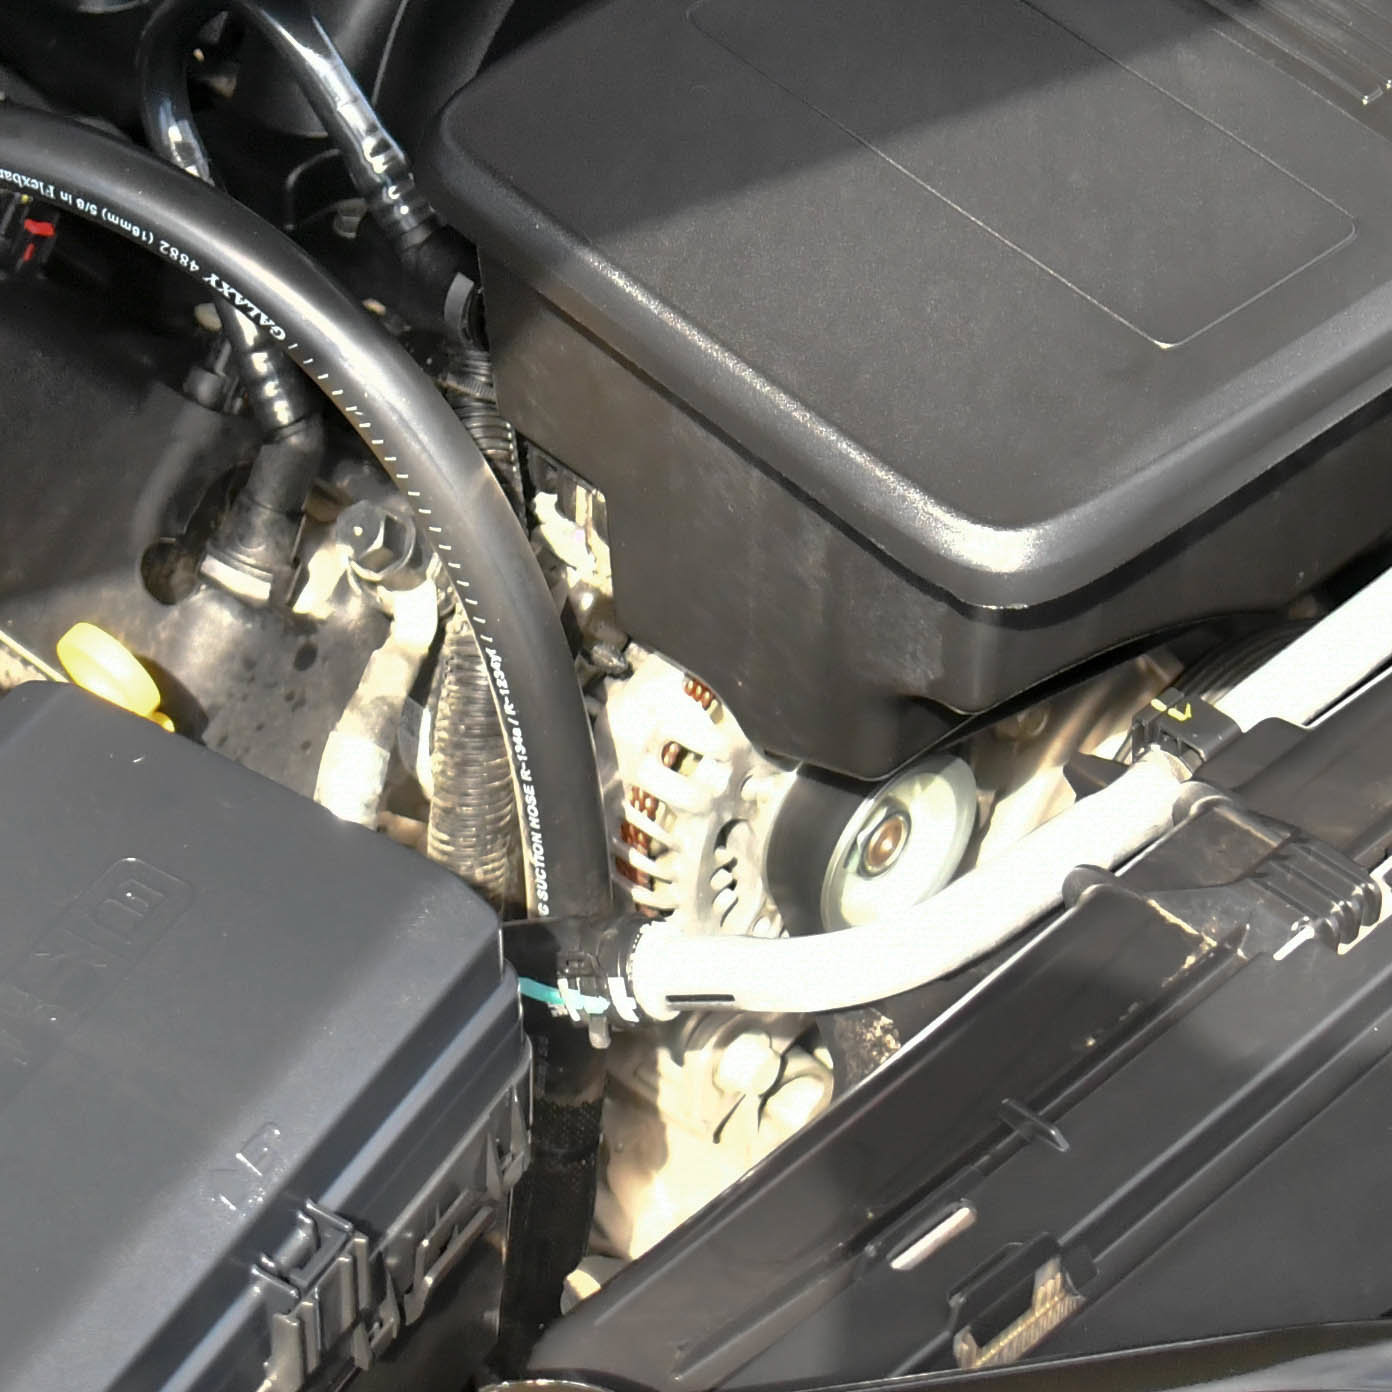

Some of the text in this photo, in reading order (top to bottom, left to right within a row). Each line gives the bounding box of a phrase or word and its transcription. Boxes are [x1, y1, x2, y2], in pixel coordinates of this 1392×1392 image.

[158, 239, 200, 274] 4882
[203, 272, 286, 342] GALAXY
[511, 727, 532, 781] R-134a
[522, 784, 541, 829] HOSE
[530, 832, 549, 901] SUCTION
